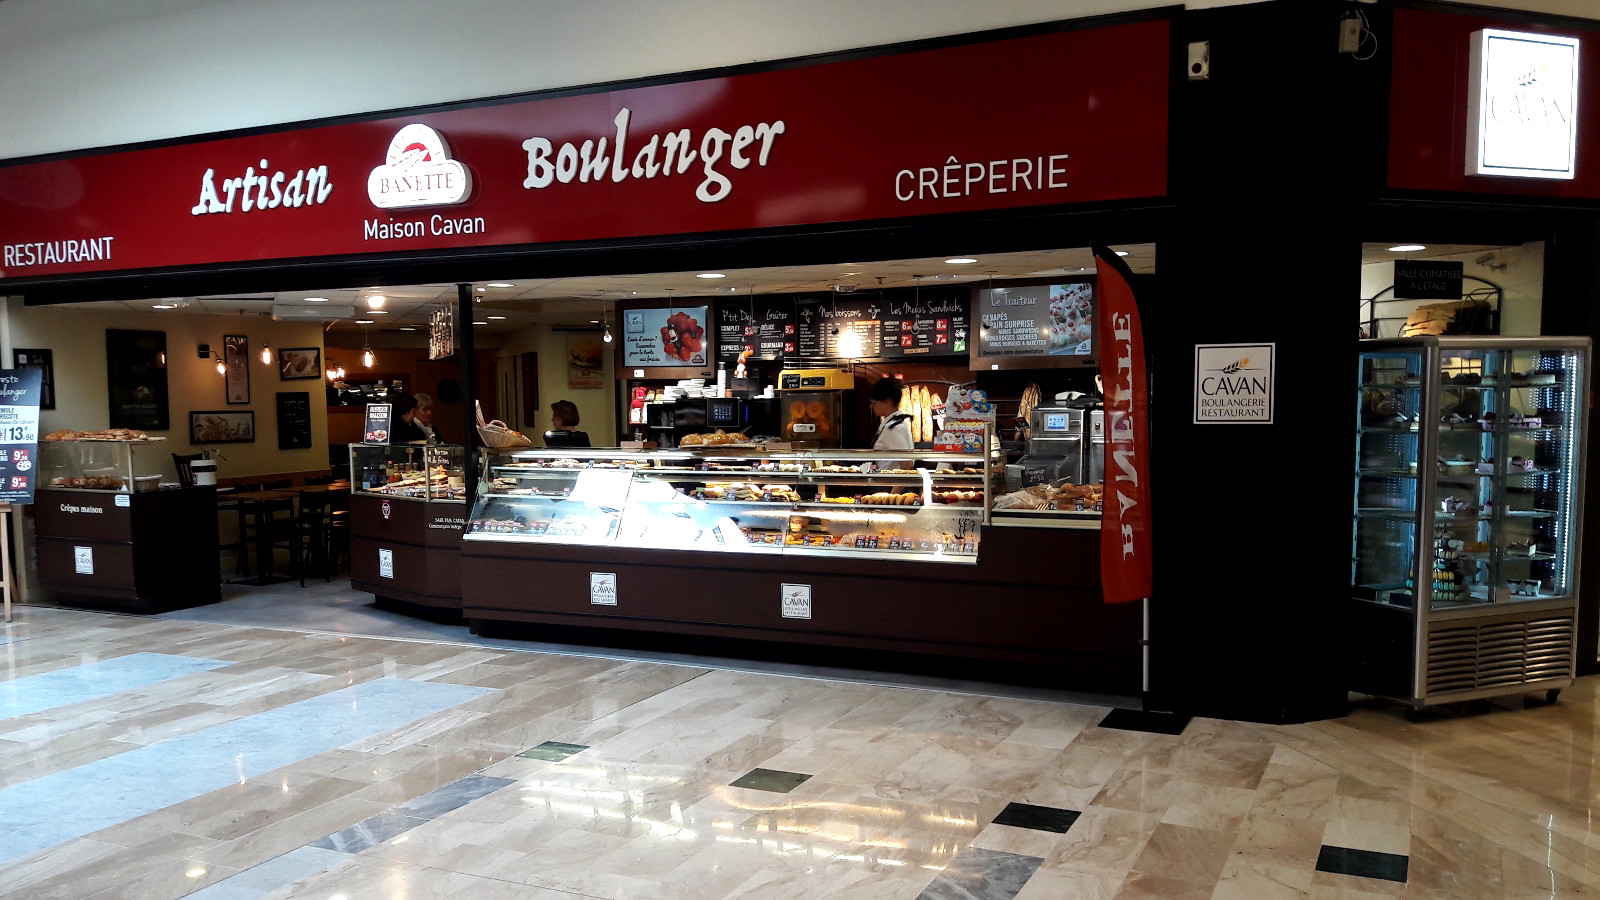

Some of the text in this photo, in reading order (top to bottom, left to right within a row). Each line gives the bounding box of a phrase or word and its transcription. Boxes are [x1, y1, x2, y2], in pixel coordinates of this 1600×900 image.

[523, 107, 785, 203] Boulanger
[379, 172, 454, 194] BANETTE
[895, 154, 1069, 202] CRÊPERIE
[192, 159, 334, 216] Artisan
[364, 213, 486, 241] Maison Cavan
[3, 236, 114, 268] RESTAURANT
[1396, 268, 1418, 278] SALLE
[1000, 290, 1039, 306] Traiteur
[818, 305, 862, 319] Nos boissons
[981, 312, 1008, 322] CANAPÉS
[1004, 319, 1035, 328] SURPRISE
[1201, 376, 1267, 396] CAVAN
[1201, 398, 1266, 408] BOULANGERIE
[1201, 408, 1266, 418] RESTAURANT
[60, 503, 104, 514] Crêpes maison
[592, 584, 615, 594] CAVAN
[784, 596, 809, 607] CAVAN
